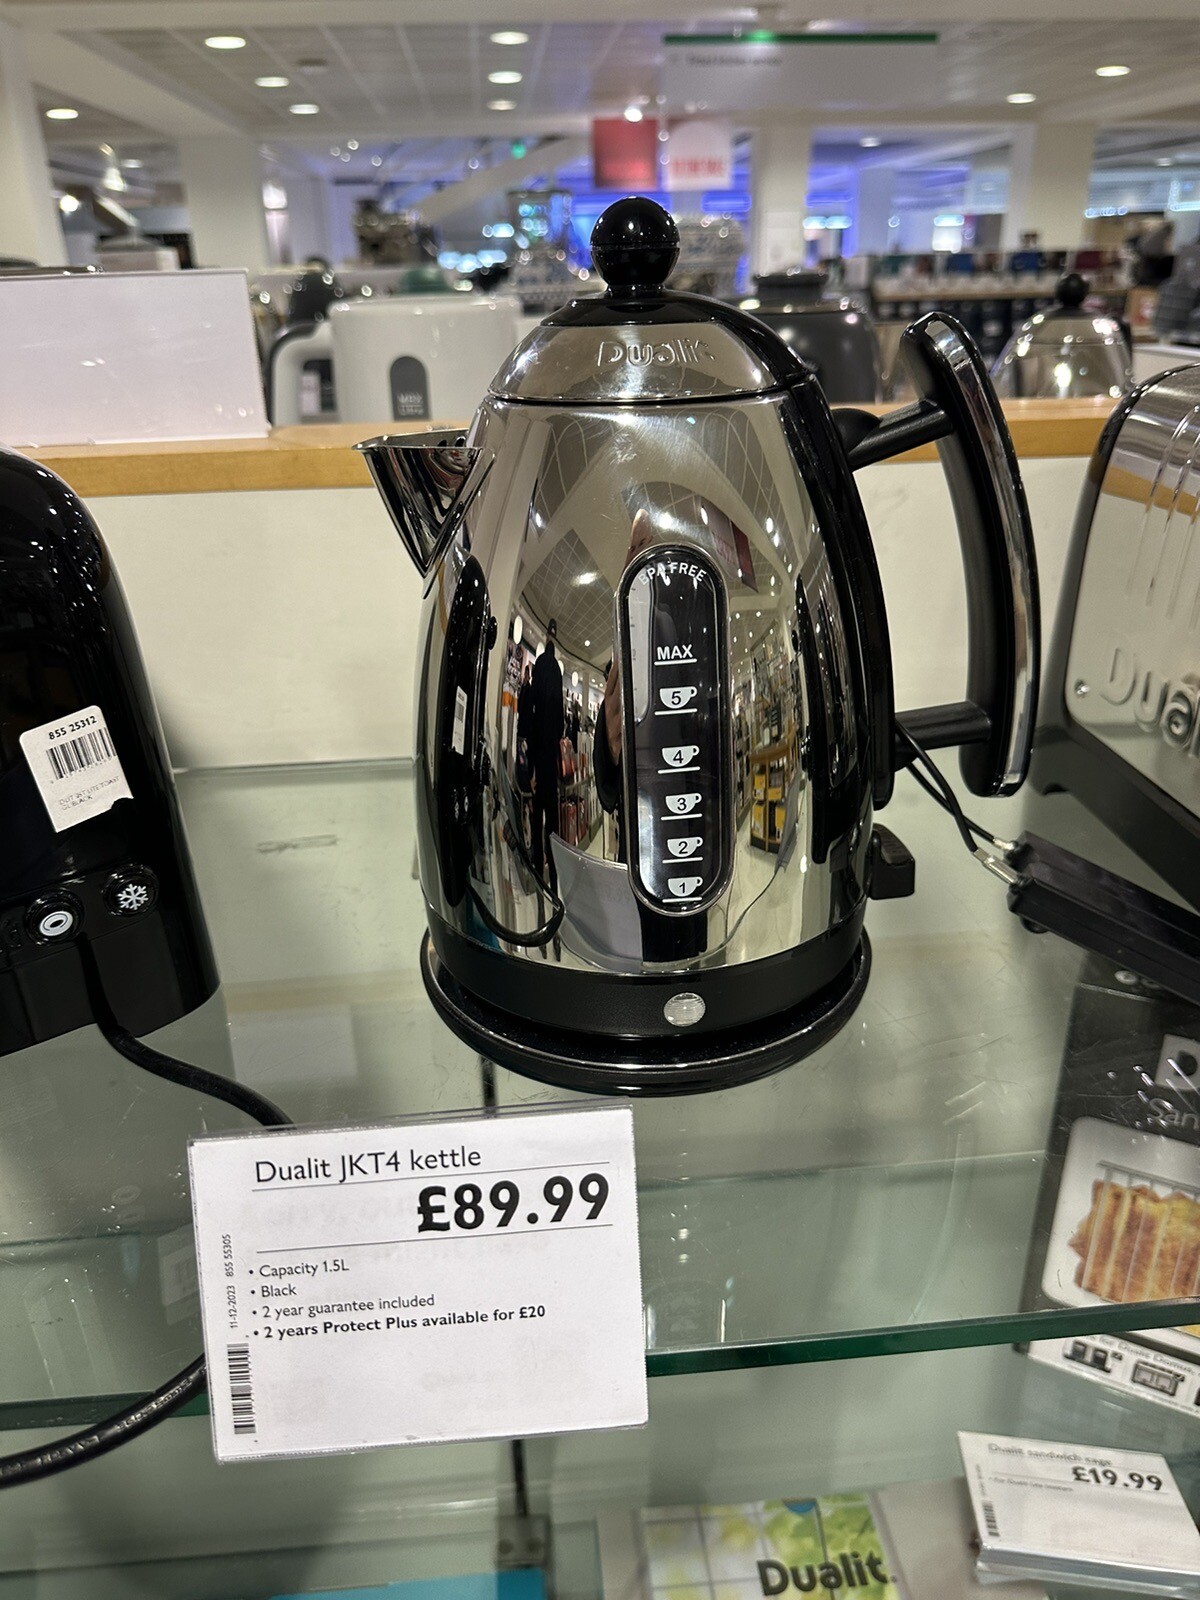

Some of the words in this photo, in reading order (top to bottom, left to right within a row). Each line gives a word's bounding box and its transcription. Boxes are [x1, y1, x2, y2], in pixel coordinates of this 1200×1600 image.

[670, 561, 707, 582] FREE
[656, 643, 693, 661] MAX
[671, 691, 682, 705] 5
[48, 726, 68, 740] 855
[68, 715, 98, 733] 25312
[673, 750, 684, 764] 4
[677, 797, 687, 811] 3
[678, 840, 688, 855] 2
[679, 882, 686, 894] 1
[255, 1157, 332, 1183] Dualit
[339, 1150, 401, 1184] JKT4
[410, 1145, 482, 1171] kettle
[416, 1172, 610, 1233] £89.99
[221, 1233, 233, 1260] 55305
[224, 1261, 235, 1278] 855
[259, 1262, 319, 1280] Capacity
[322, 1258, 350, 1273] 1.5L
[260, 1283, 298, 1298] Black
[226, 1284, 239, 1329] 11-12-2023
[262, 1305, 272, 1319] 2
[275, 1305, 304, 1321] year
[307, 1300, 375, 1319] guarantee
[378, 1293, 435, 1310] included
[263, 1326, 273, 1339] 2
[277, 1325, 319, 1341] years
[323, 1317, 381, 1334] Protect
[386, 1316, 418, 1330] Plus
[421, 1310, 489, 1327] available
[492, 1308, 515, 1322] for
[518, 1304, 546, 1320] £20
[1071, 1465, 1164, 1492] £19.99
